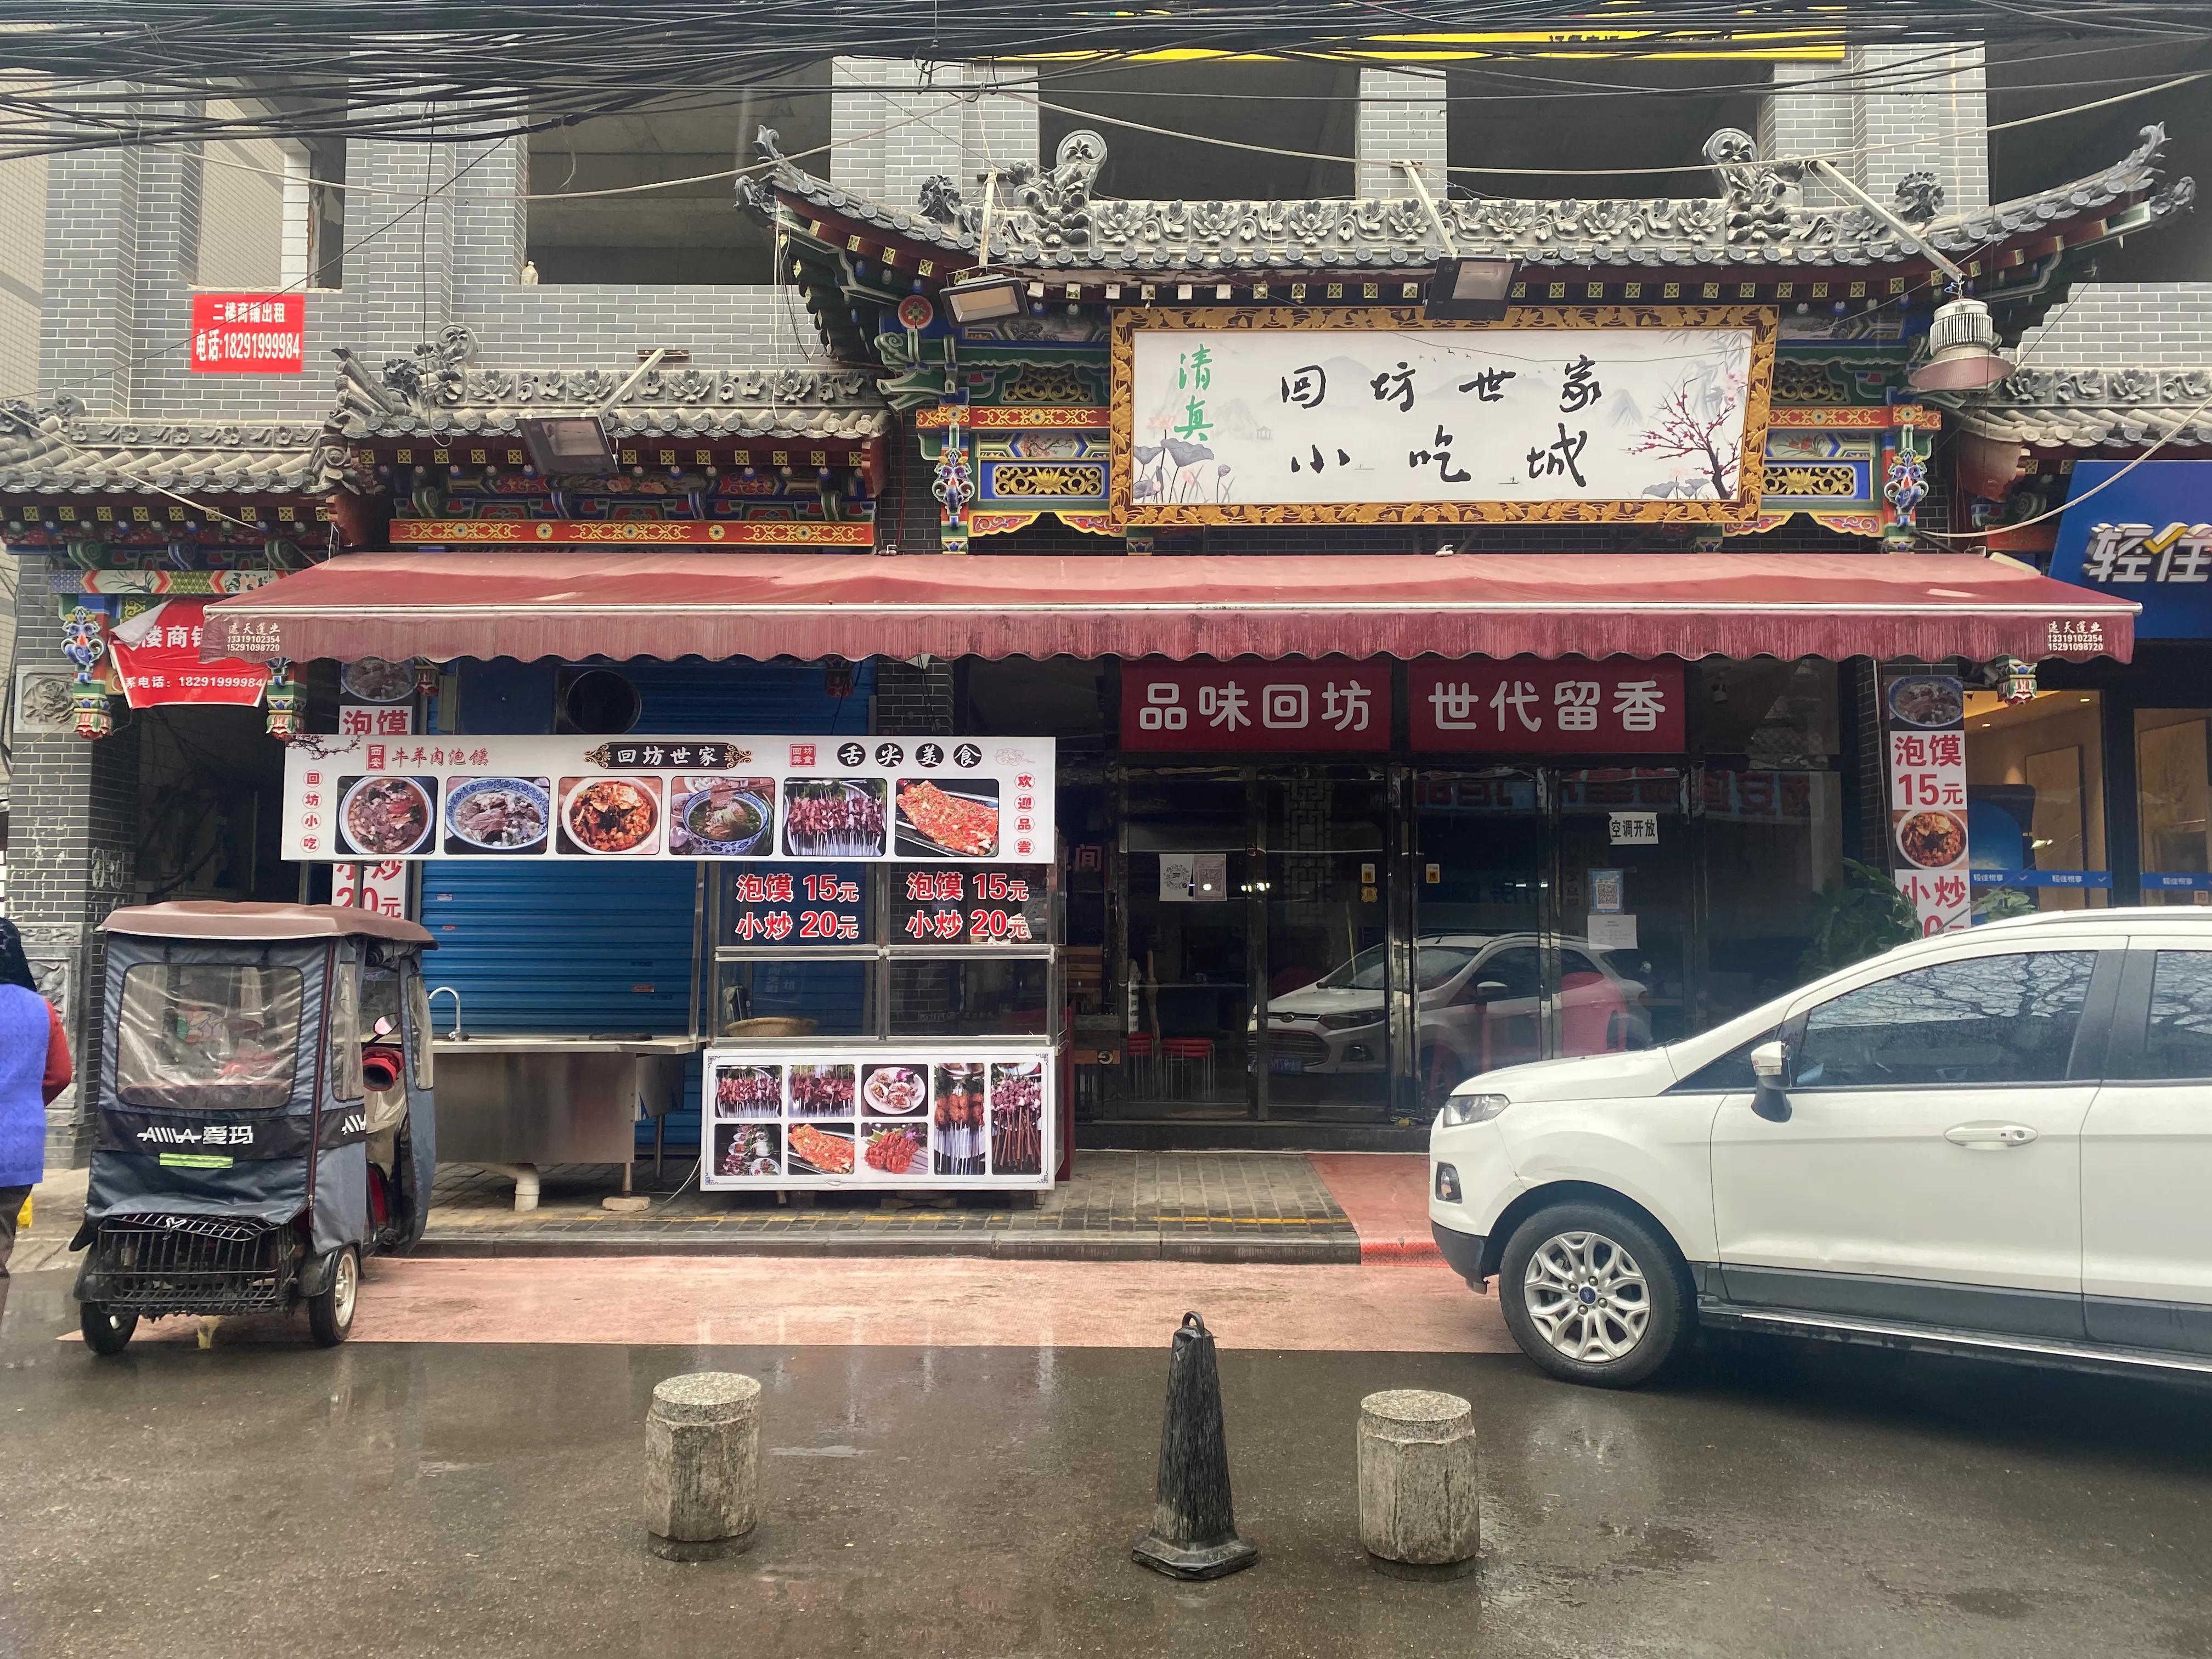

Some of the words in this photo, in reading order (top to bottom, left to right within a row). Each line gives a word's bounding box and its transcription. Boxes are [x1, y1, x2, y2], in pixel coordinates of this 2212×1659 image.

[212, 301, 285, 323] 二楼商铺出租
[1173, 343, 1215, 442] 清真
[1281, 354, 1602, 413] 回坊世家
[1290, 423, 1588, 489] 小吃城
[227, 635, 280, 644] 13319102354
[227, 644, 280, 652] 15291098720
[2048, 634, 2103, 642] 13319102354
[2048, 643, 2103, 651] 15291098720
[1139, 680, 1372, 732] 品味回坊
[1428, 680, 1666, 732] 世代留香
[391, 746, 489, 768] 牛羊肉泡馍
[617, 746, 718, 766] 回坊世家
[840, 744, 981, 767] 舌尖美食
[1894, 733, 1963, 768] 泡馍
[1898, 774, 1964, 806] 15元
[303, 772, 319, 850] 回坊小吃
[1017, 775, 1032, 853] 欢迎品尝
[1611, 819, 1656, 838] 空调开放
[736, 873, 794, 904] 泡馍
[803, 874, 860, 904] 15元
[906, 872, 963, 902] 泡馍
[973, 873, 1029, 903] 15元
[1902, 876, 1966, 909] 小炒
[736, 911, 793, 941] 小炒
[800, 910, 860, 940] 20元
[906, 910, 963, 940] 小炒
[970, 909, 1029, 939] 20元
